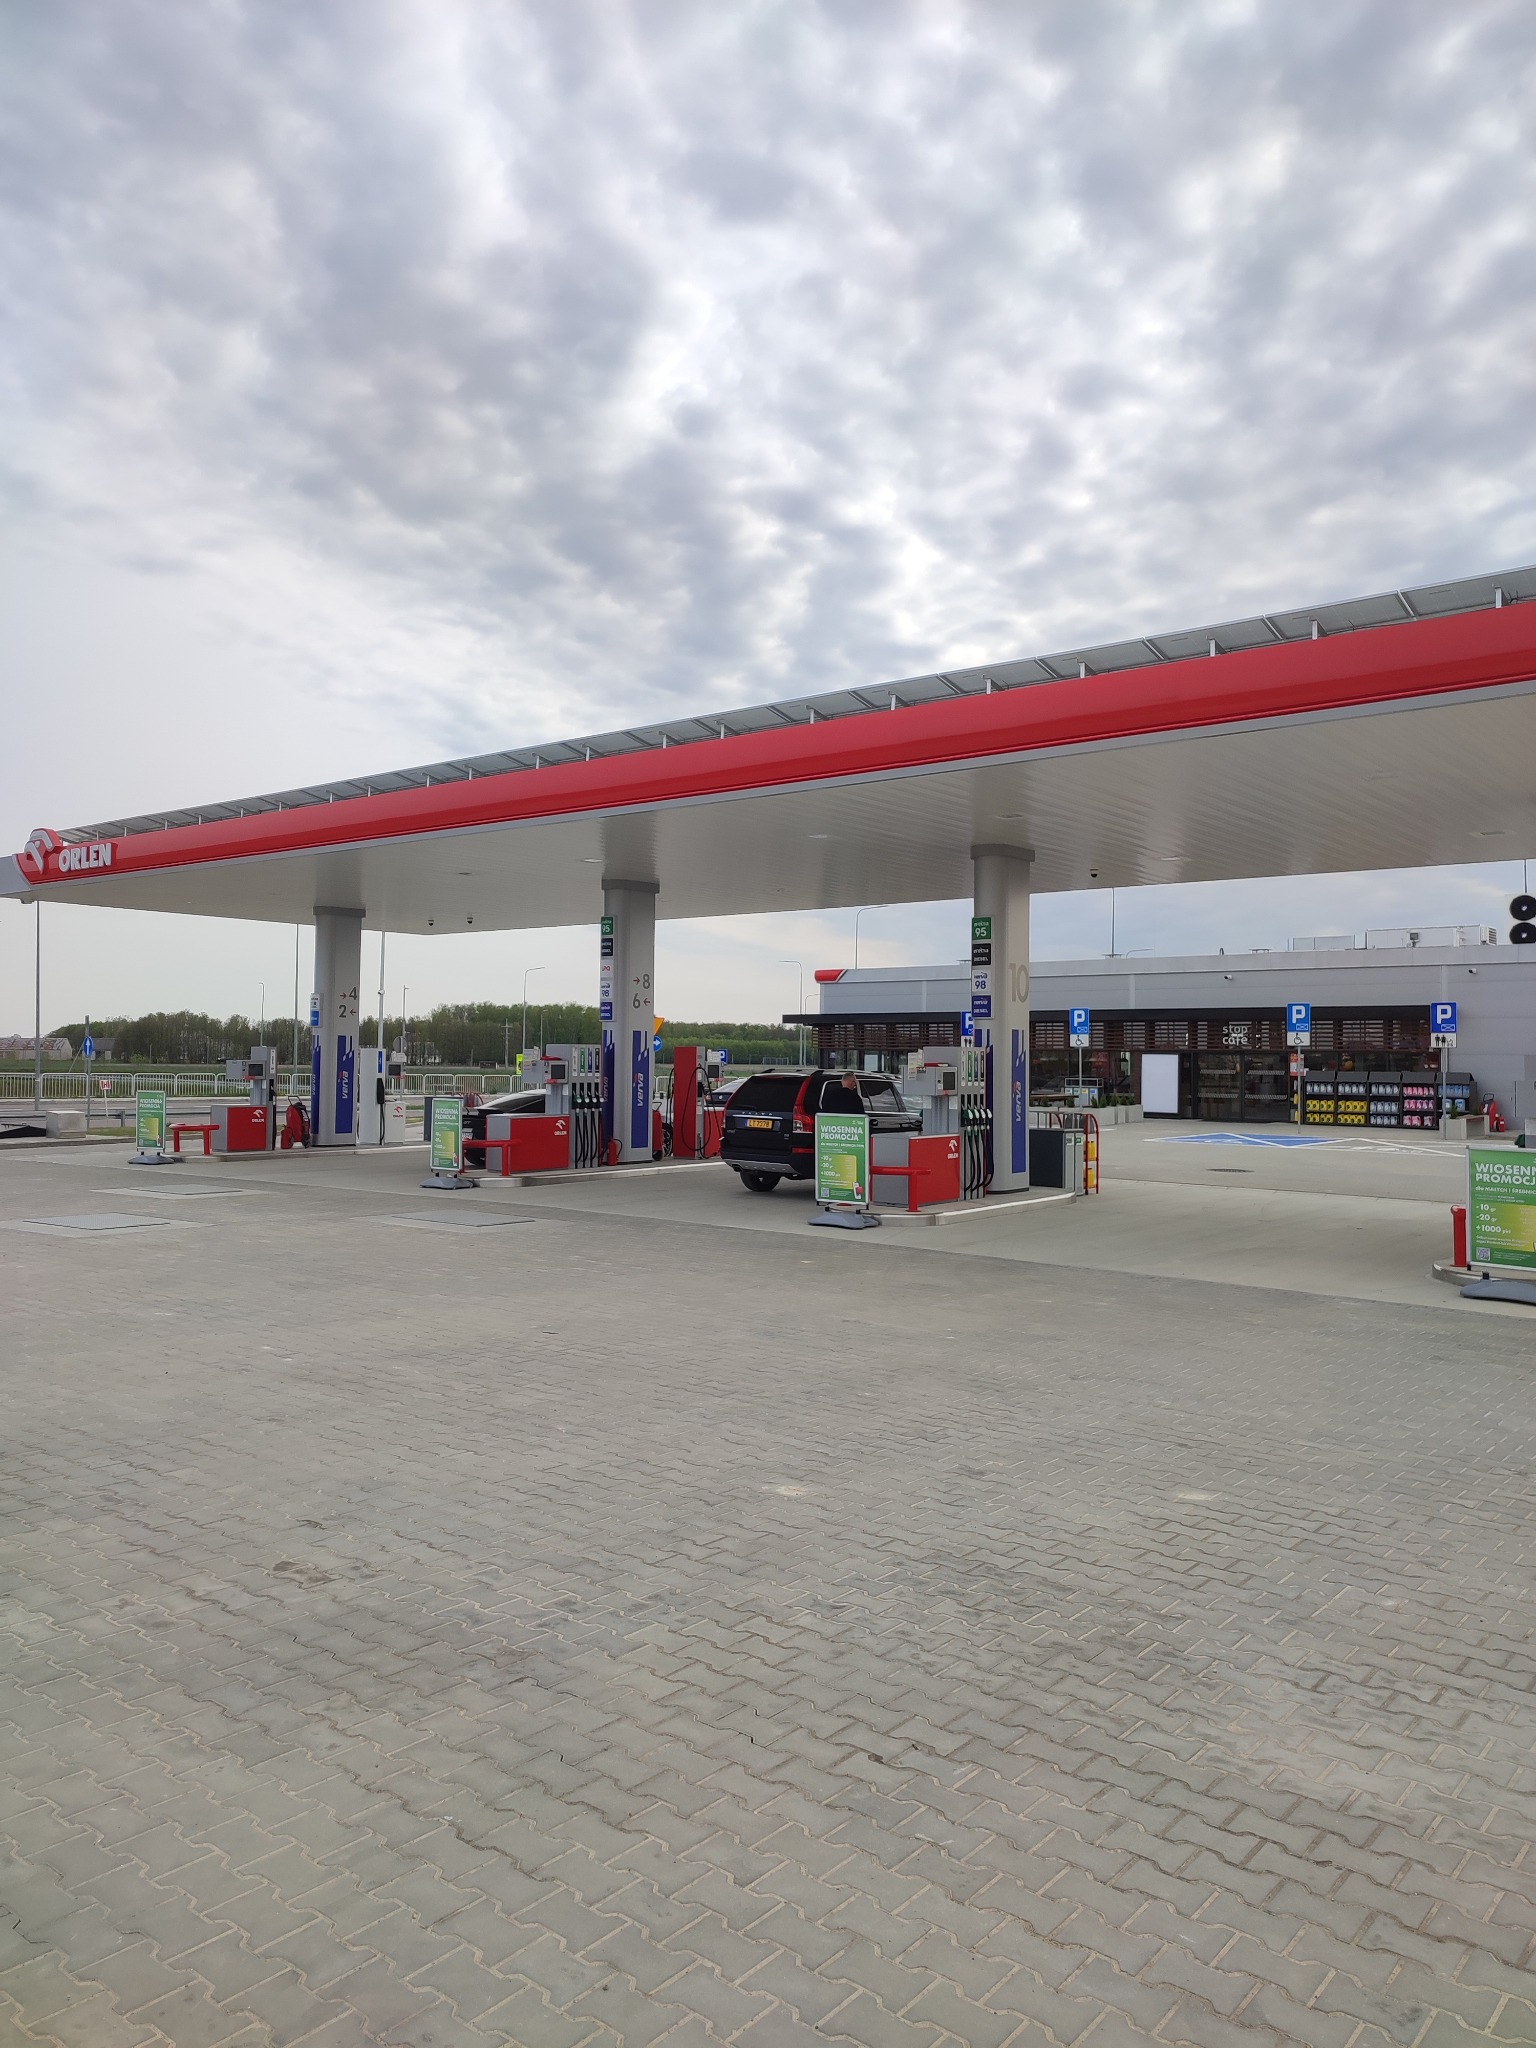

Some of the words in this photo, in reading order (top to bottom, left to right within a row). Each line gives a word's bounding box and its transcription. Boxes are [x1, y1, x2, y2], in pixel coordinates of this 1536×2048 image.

[59, 843, 111, 872] ORLEN
[975, 928, 987, 937] 95
[643, 974, 650, 989] 8
[975, 981, 986, 989] 98
[1008, 963, 1029, 1003] 10
[349, 987, 357, 1000] 4
[633, 993, 640, 1009] 6
[339, 1005, 347, 1018] 2
[1291, 1005, 1305, 1024] P
[1436, 1005, 1451, 1024] P
[1074, 1010, 1085, 1027] P
[1222, 1025, 1248, 1036] stop
[1222, 1034, 1248, 1046] cafe
[821, 1125, 863, 1135] WIOSENNA
[821, 1132, 859, 1142] PROMOCJA
[1476, 1225, 1501, 1233] +1000
